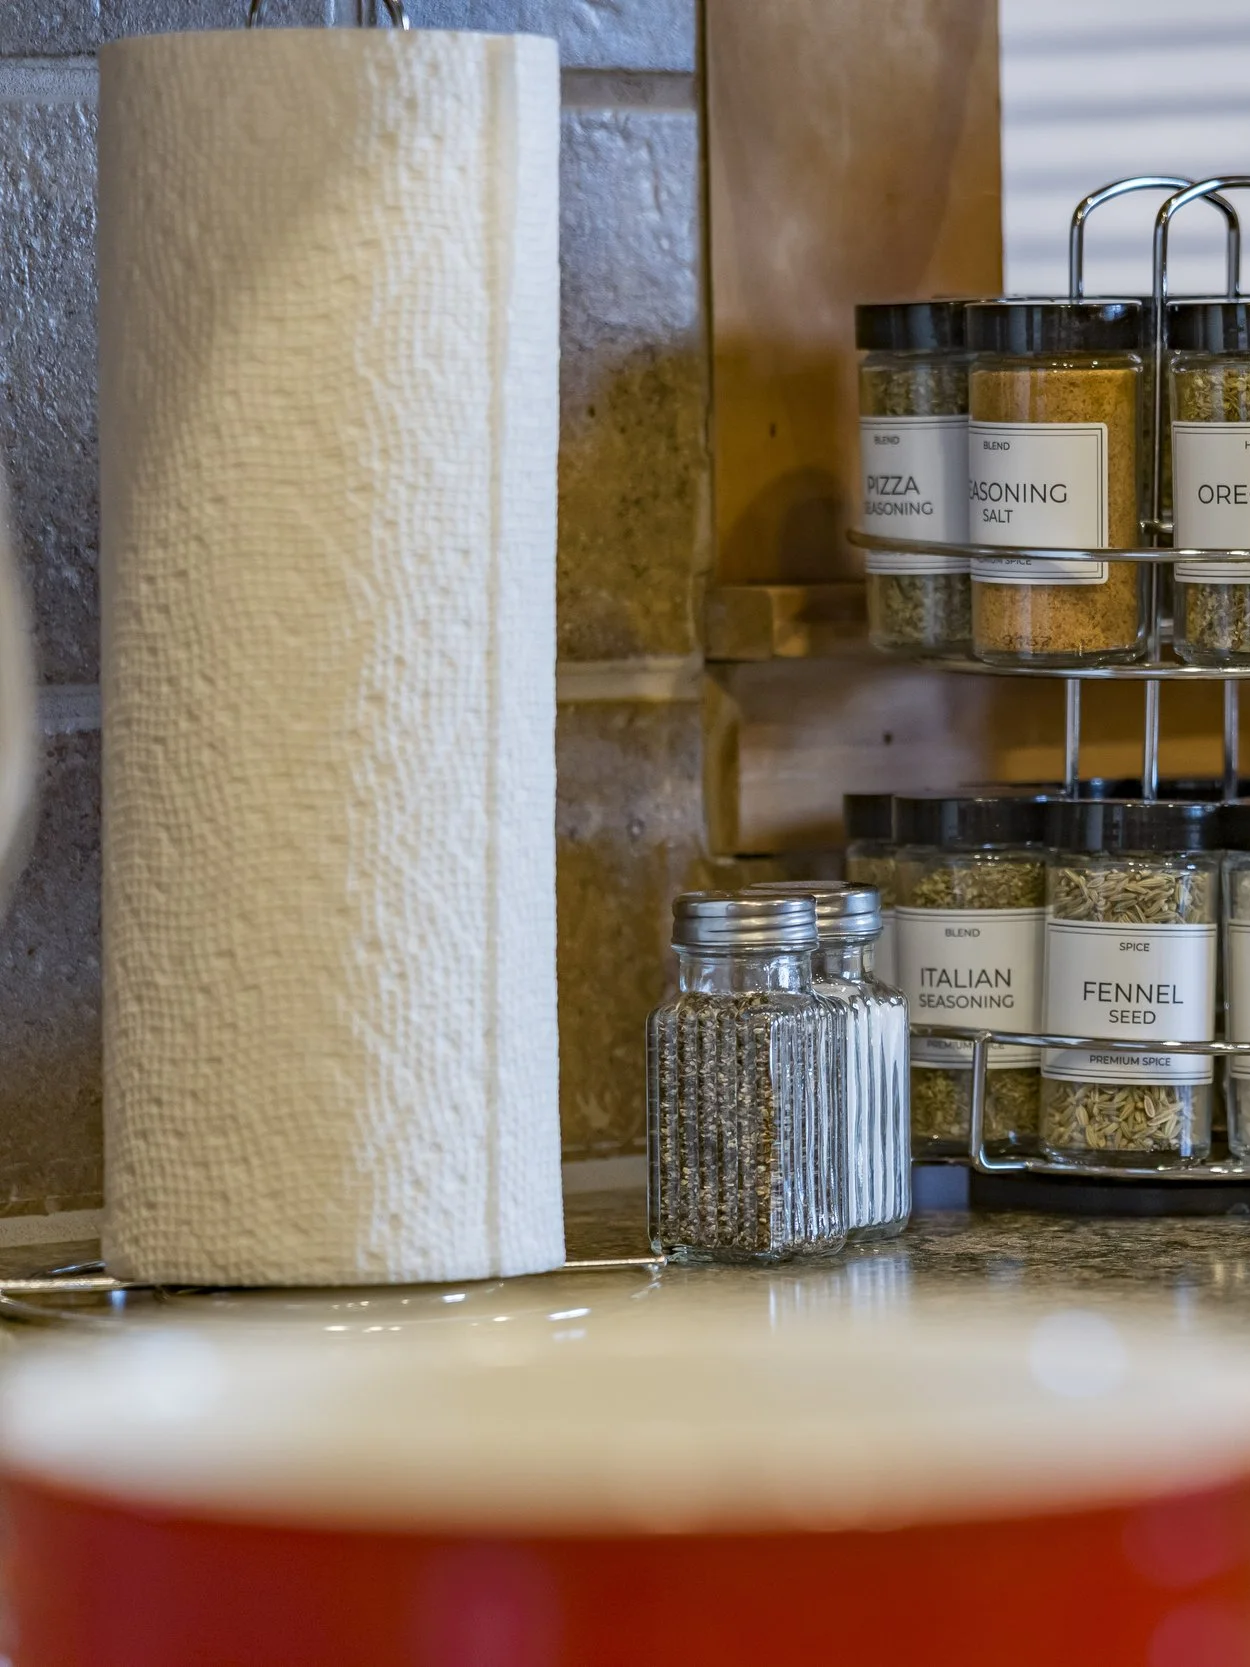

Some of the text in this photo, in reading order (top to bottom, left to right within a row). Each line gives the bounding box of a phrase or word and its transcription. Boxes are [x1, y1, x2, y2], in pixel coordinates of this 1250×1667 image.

[874, 435, 900, 446] BLEND
[983, 440, 1010, 451] BLEND
[867, 475, 920, 496] PIZZA
[969, 480, 1067, 504] EASONING
[982, 508, 1013, 523] SALT
[945, 928, 980, 938] BLEND
[1119, 942, 1150, 952] SPICE
[920, 967, 1012, 989] ITALIAN
[1083, 981, 1184, 1005] FENNEL
[918, 994, 1014, 1009] SEASONING
[1108, 1009, 1157, 1025] SEED
[1089, 1054, 1171, 1067] PREMIUM SPICE
